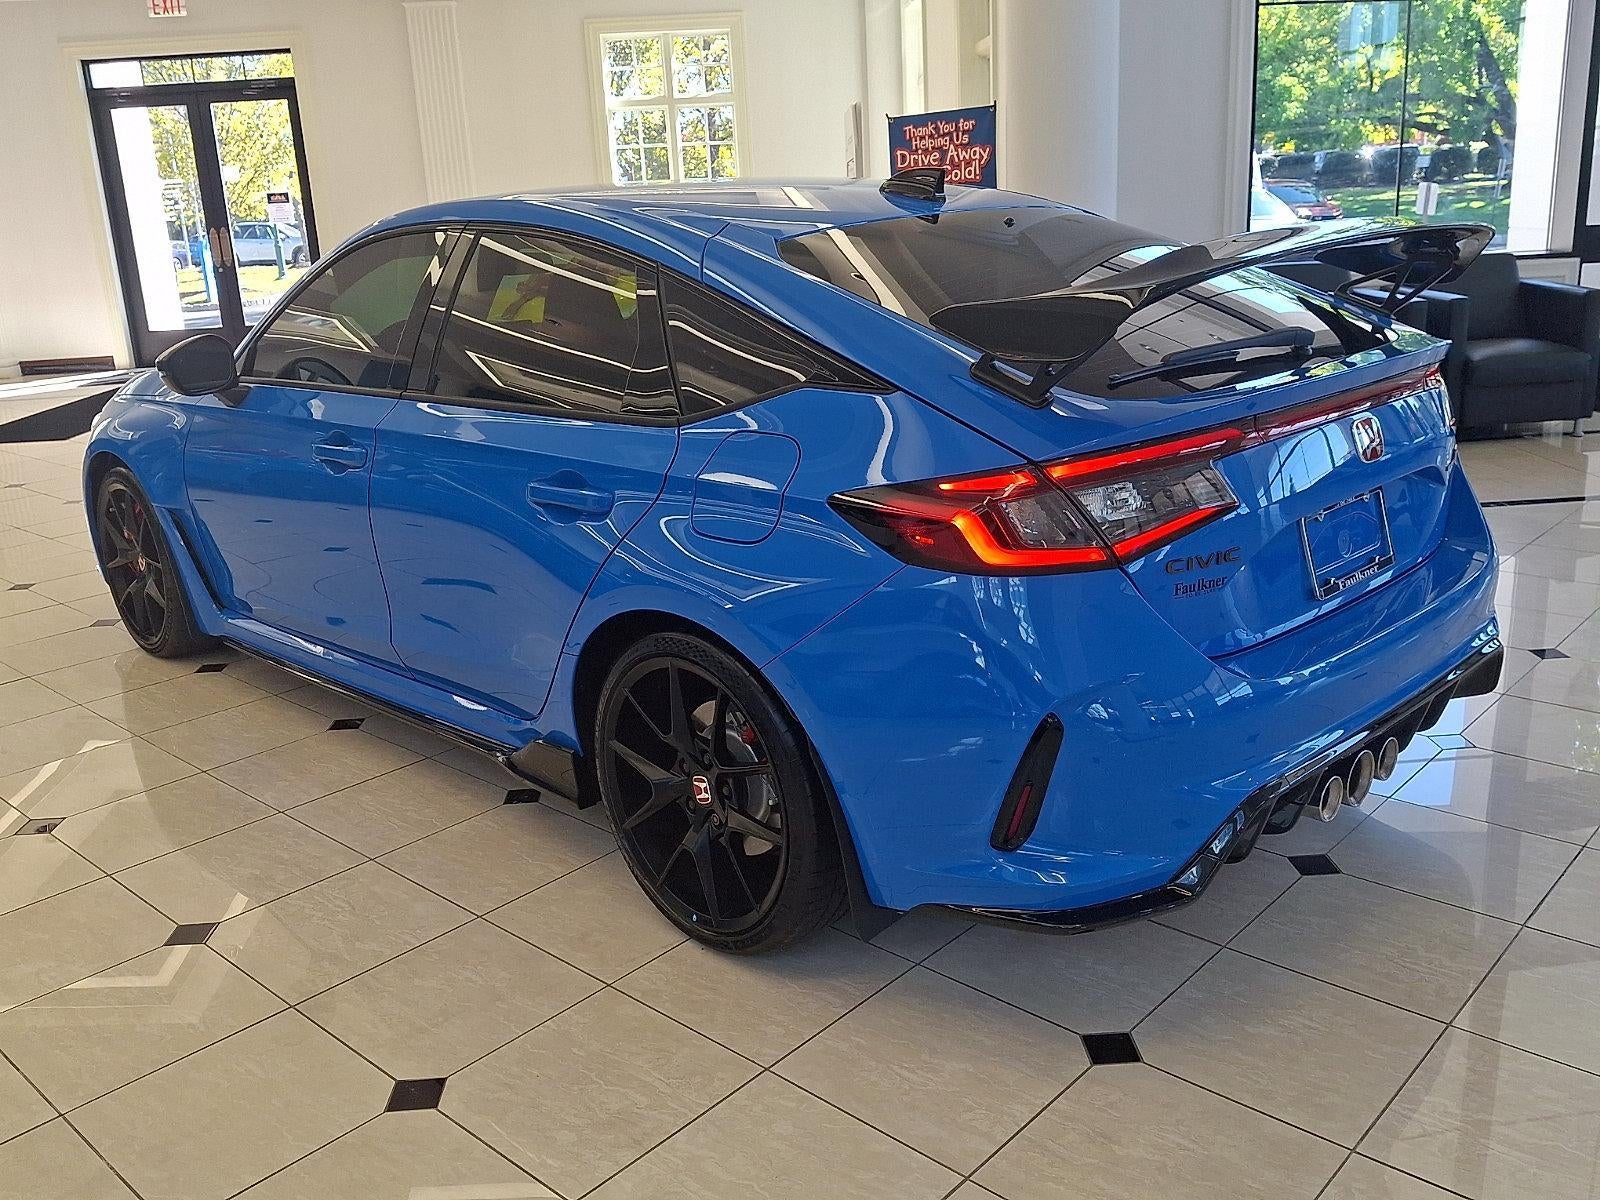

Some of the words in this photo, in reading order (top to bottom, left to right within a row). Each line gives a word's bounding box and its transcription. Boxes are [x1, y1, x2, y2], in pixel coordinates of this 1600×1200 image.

[904, 123, 936, 140] Thank
[939, 121, 956, 134] You
[959, 118, 976, 131] for
[912, 135, 950, 151] Helping
[953, 132, 969, 144] Us
[896, 150, 940, 168] Drive
[945, 145, 990, 165] Away
[1165, 546, 1241, 574] CIVIC
[1173, 576, 1227, 597] Faulkner
[1338, 565, 1380, 590] Faulkner
